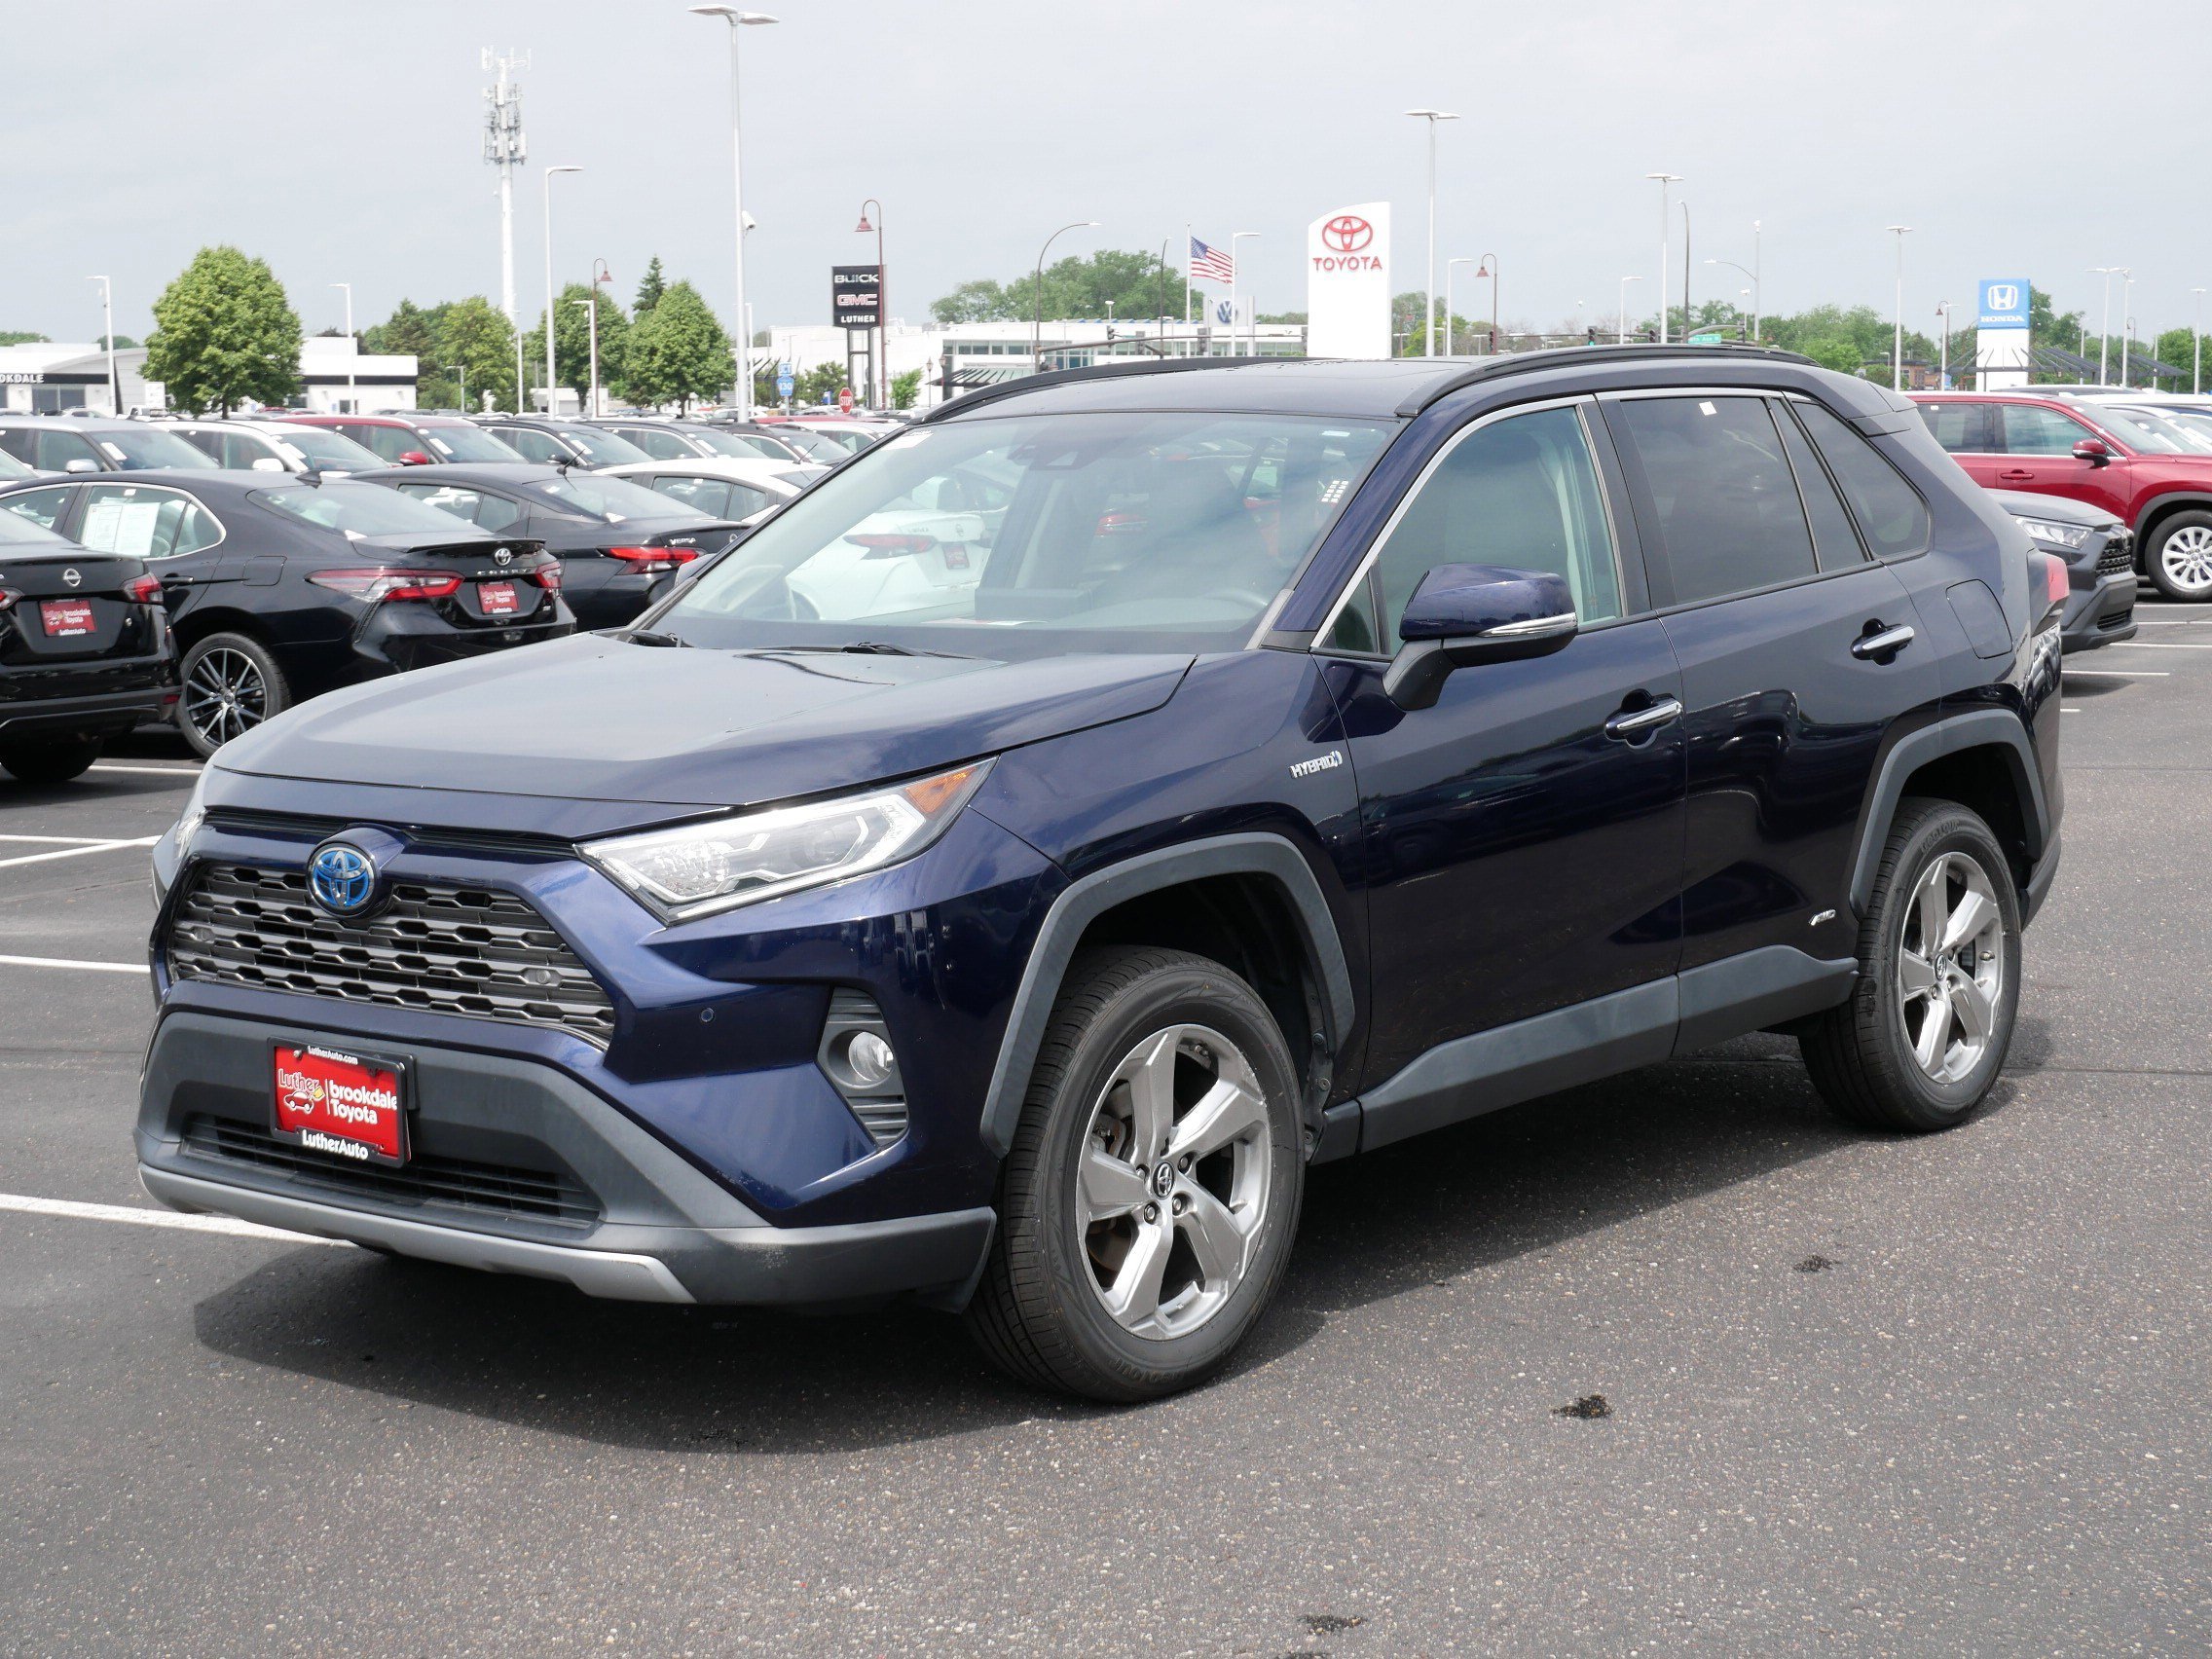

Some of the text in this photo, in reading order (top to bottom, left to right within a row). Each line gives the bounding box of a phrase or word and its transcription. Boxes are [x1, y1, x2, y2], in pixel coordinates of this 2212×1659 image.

[1312, 256, 1382, 271] TOYOTA
[834, 274, 879, 283] BUICK
[837, 293, 877, 306] GMC
[840, 314, 875, 323] LUTHER
[0, 374, 45, 384] OKDALE
[840, 395, 853, 407] STOP
[1289, 755, 1336, 778] HYBRID
[307, 1045, 358, 1065] LutherAuto.com
[277, 1068, 320, 1092] Luther
[329, 1079, 398, 1111] brookdale
[329, 1098, 378, 1124] Toyota
[302, 1128, 369, 1161] LutherAuto
